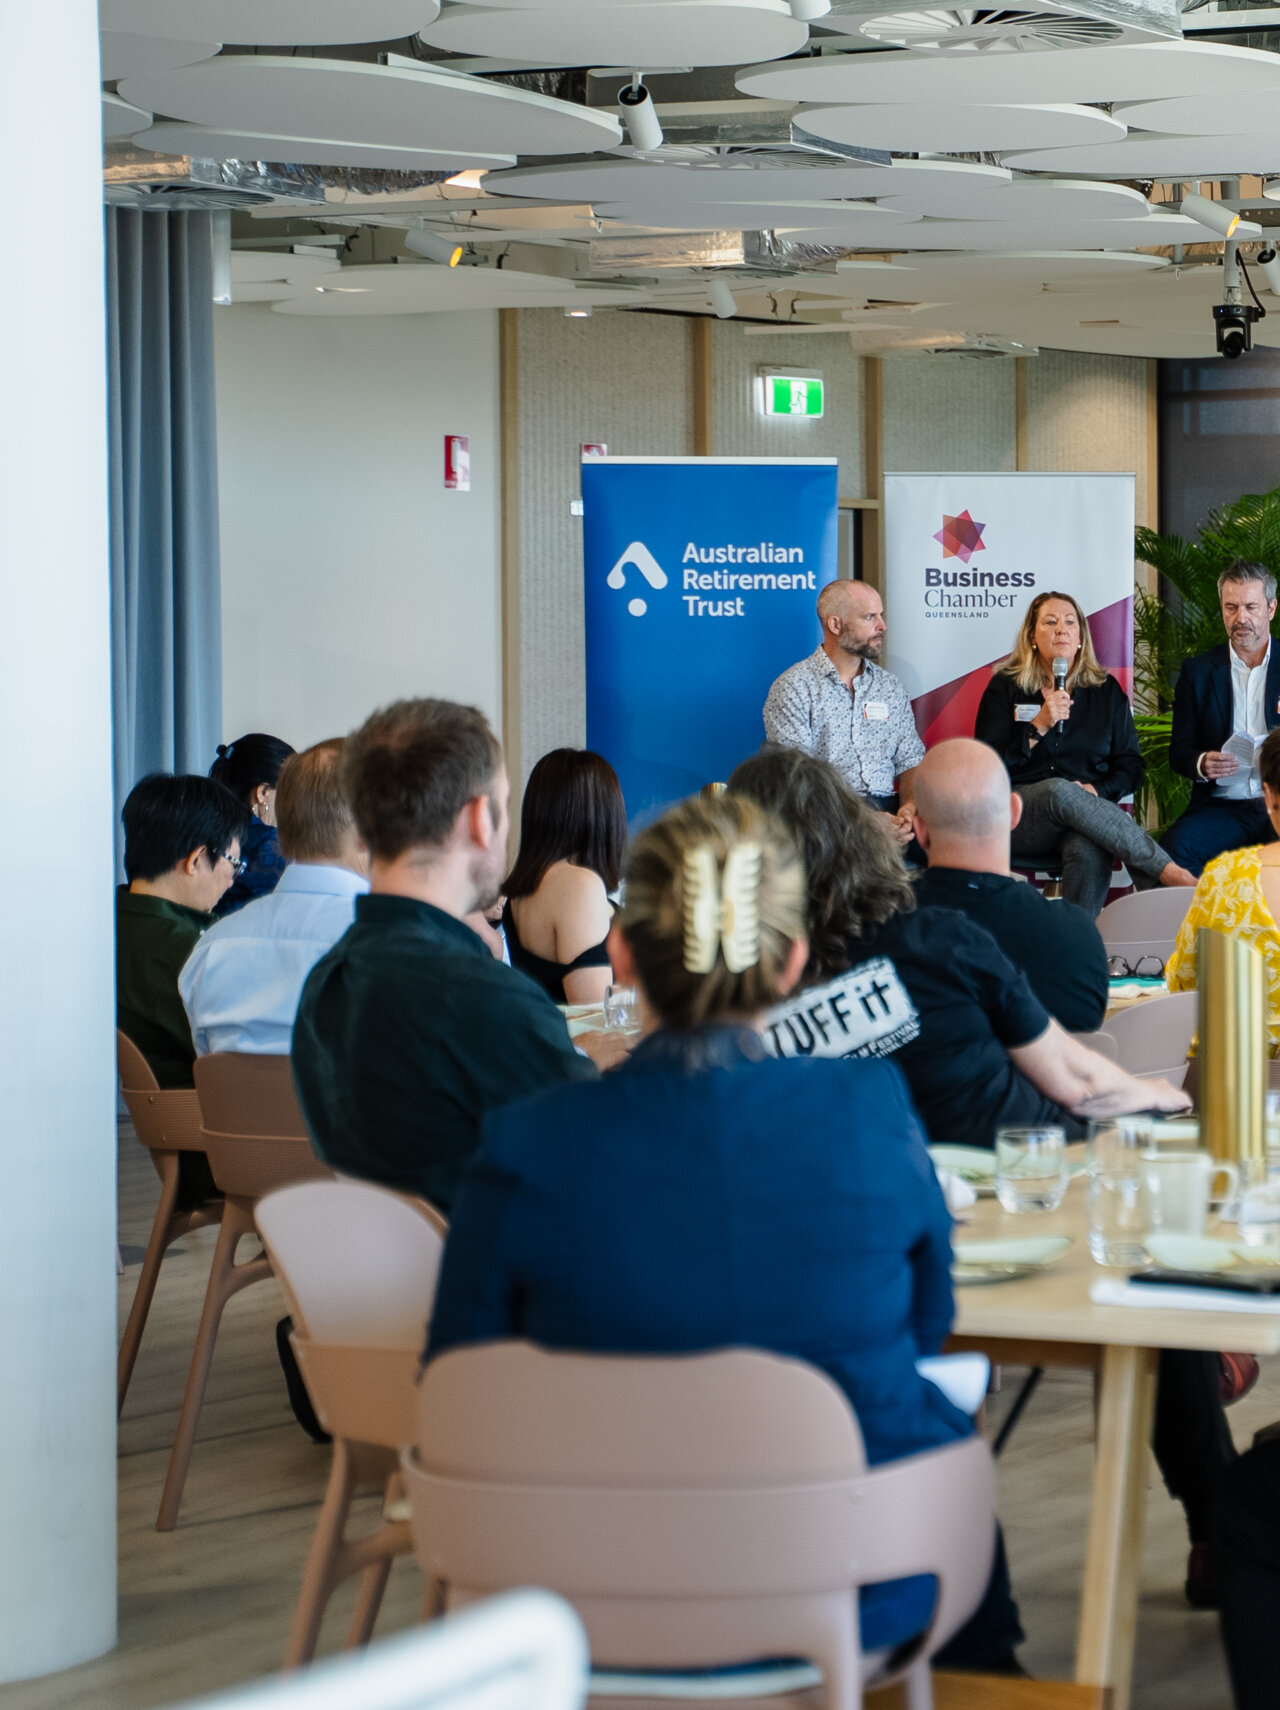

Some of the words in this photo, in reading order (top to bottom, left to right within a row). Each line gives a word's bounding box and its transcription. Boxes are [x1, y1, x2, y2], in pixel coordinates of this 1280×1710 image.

[682, 542, 804, 563] Australian
[682, 570, 816, 590] Retirement
[925, 568, 1035, 588] Business
[682, 596, 745, 617] Trust
[925, 589, 1017, 608] Chamber
